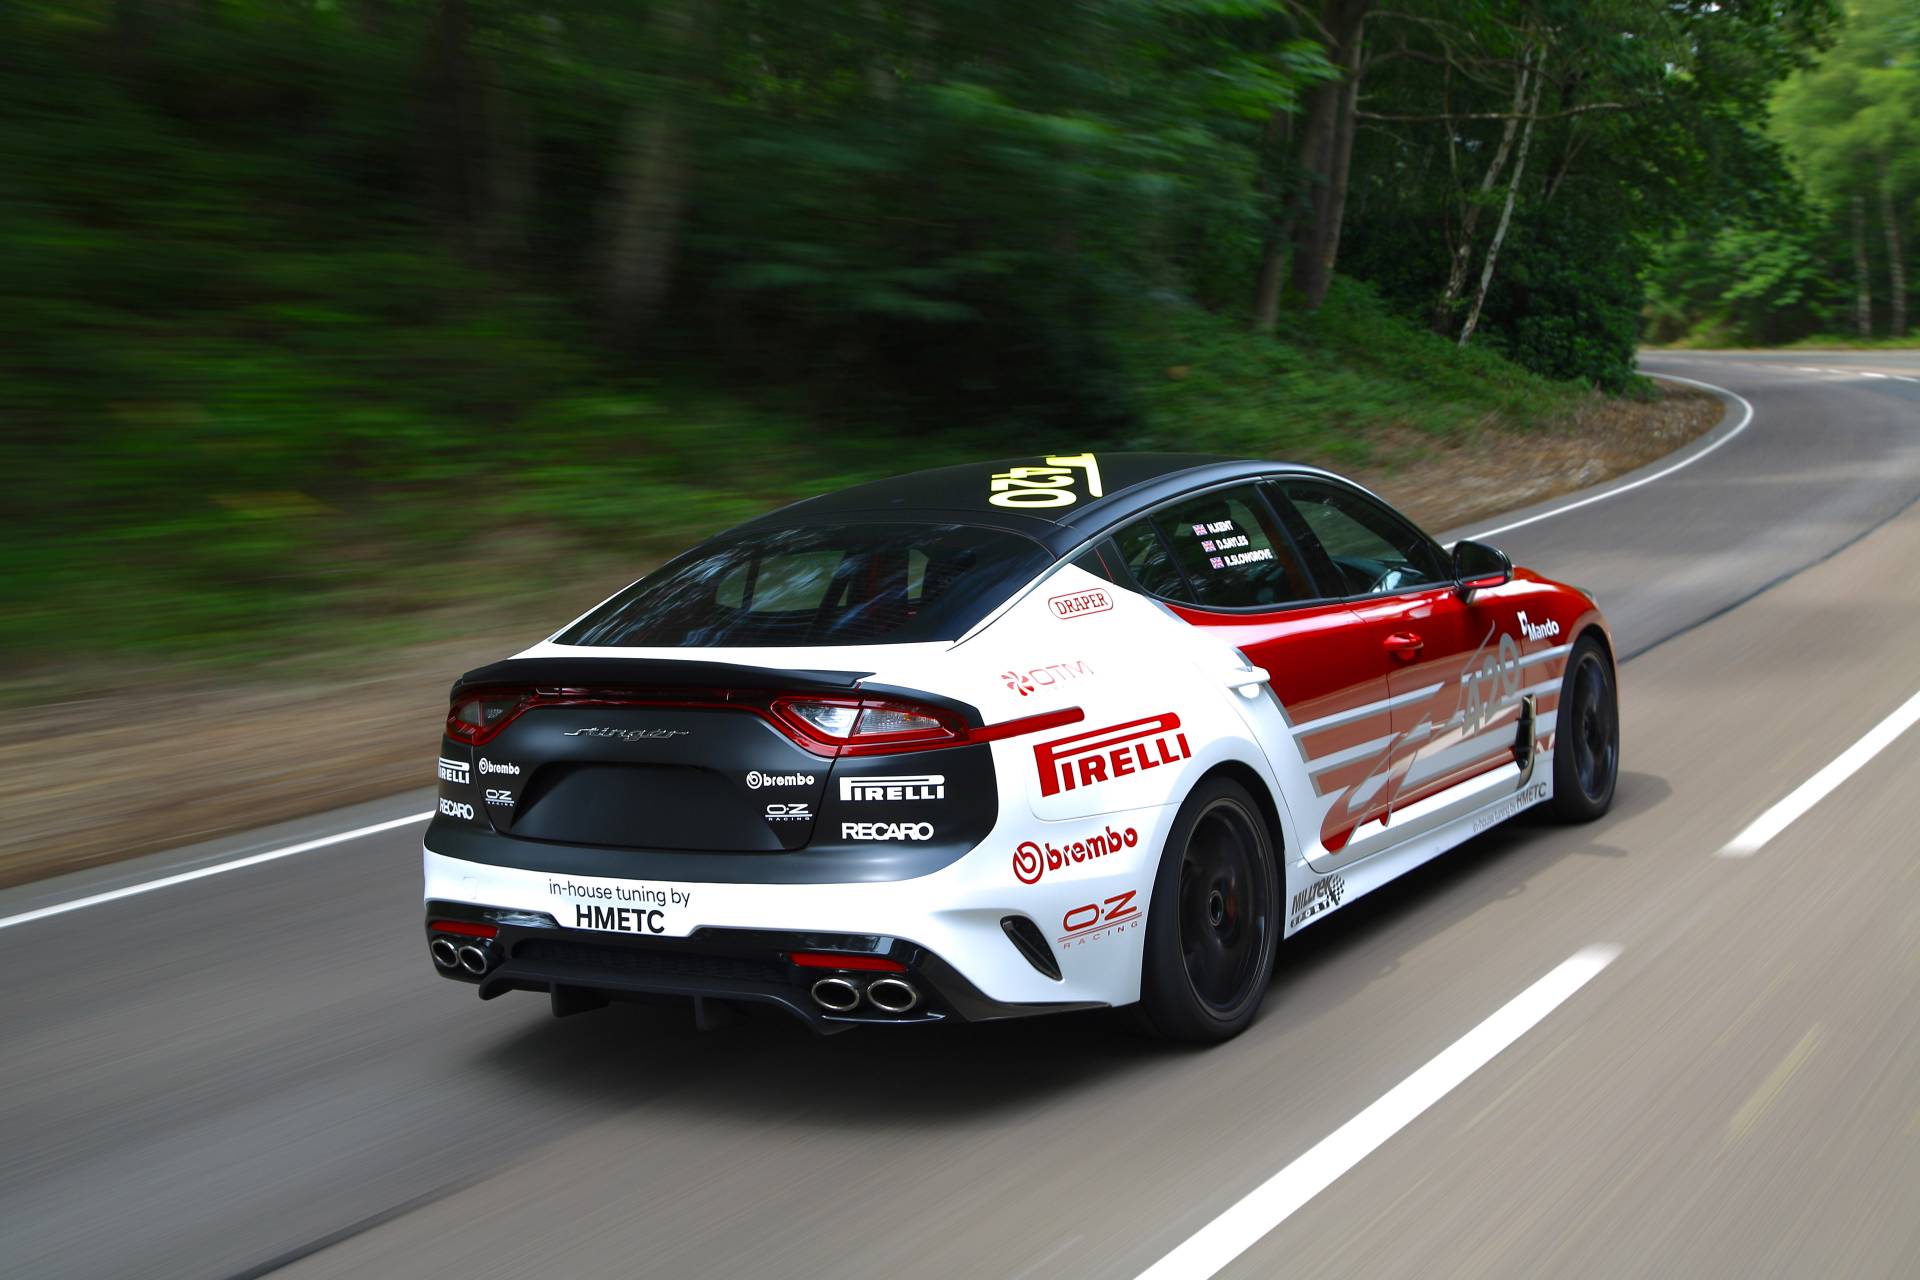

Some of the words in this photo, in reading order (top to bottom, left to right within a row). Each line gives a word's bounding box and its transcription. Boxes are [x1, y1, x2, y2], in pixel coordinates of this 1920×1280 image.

[1054, 592, 1109, 616] DRAPER
[1527, 618, 1560, 642] Mando
[1033, 711, 1192, 798] PIRELLI
[488, 762, 520, 775] brembo
[763, 773, 815, 787] brembo
[840, 775, 945, 801] PIRELLI
[440, 798, 475, 820] RECARO
[841, 821, 934, 841] RECARO
[1045, 825, 1138, 871] brembo
[549, 878, 612, 899] in-house
[616, 885, 666, 907] tuning
[670, 888, 690, 908] by
[576, 904, 665, 934] HMETC
[1063, 920, 1138, 950] RACING
